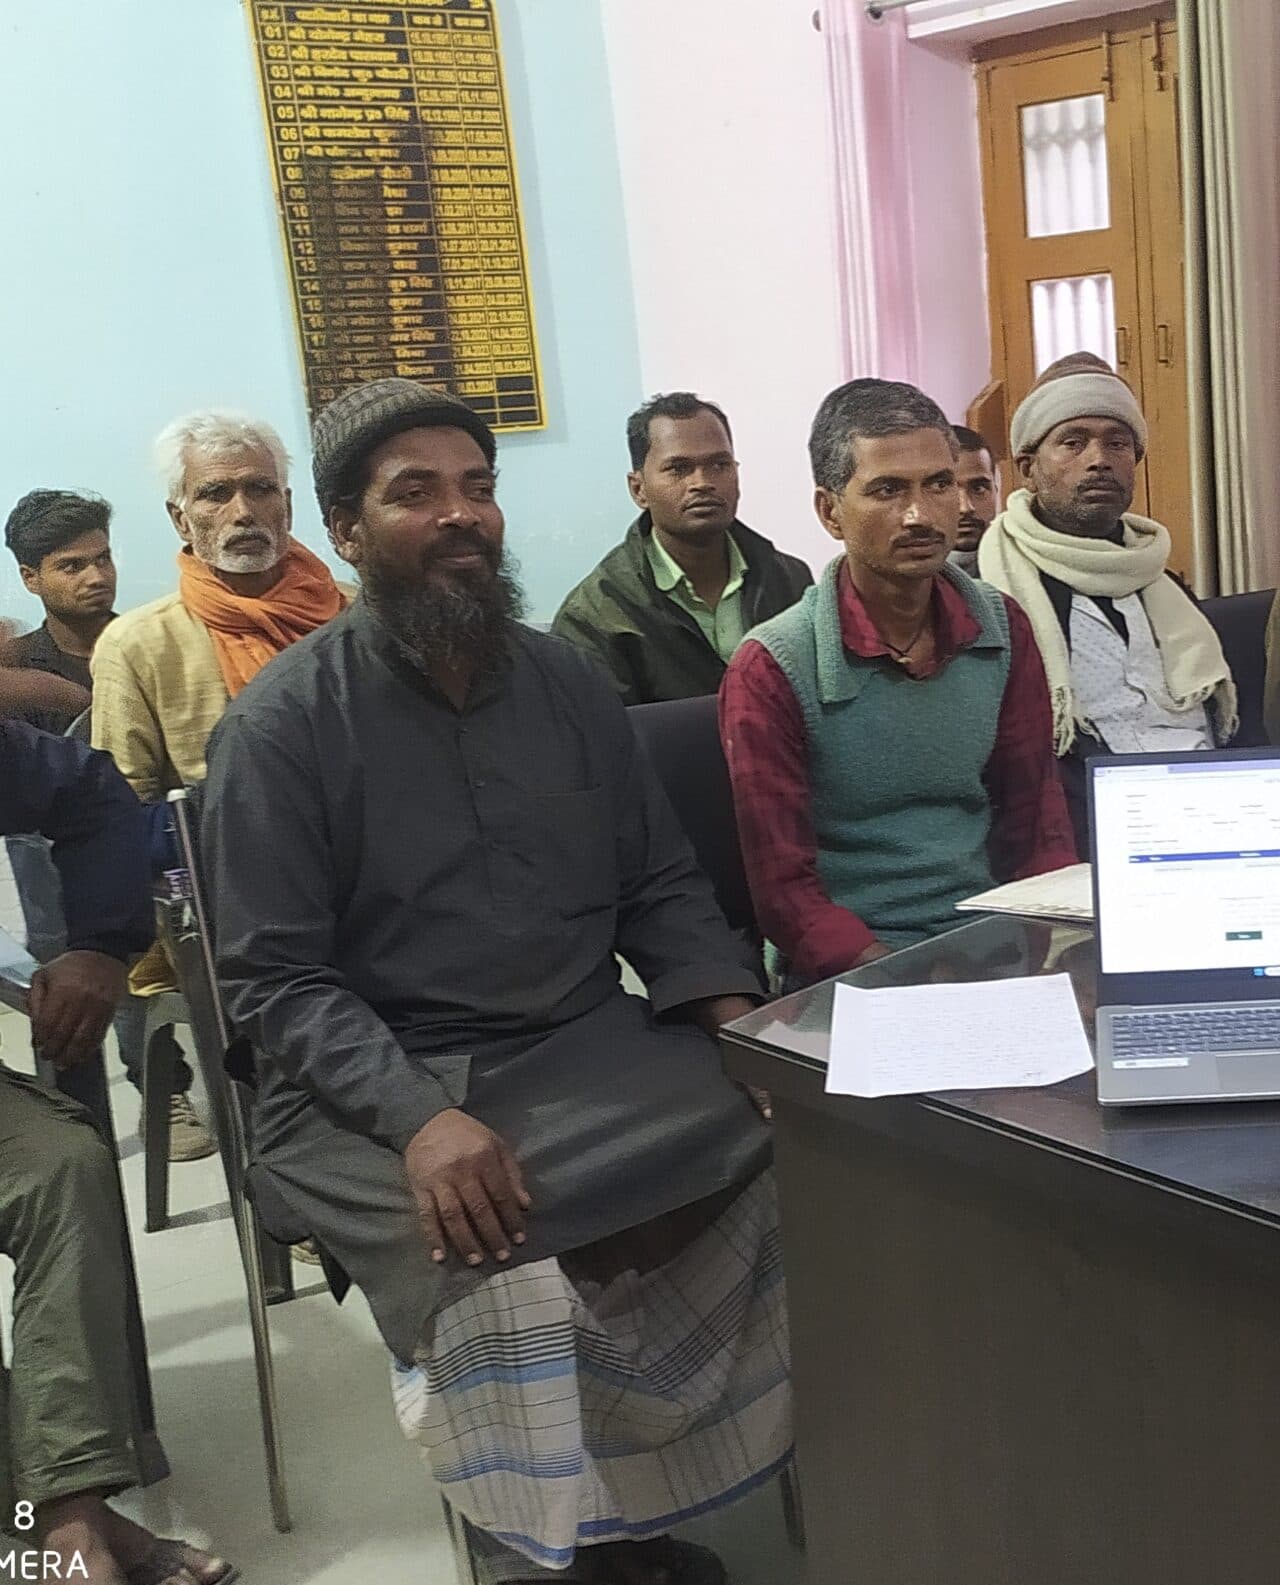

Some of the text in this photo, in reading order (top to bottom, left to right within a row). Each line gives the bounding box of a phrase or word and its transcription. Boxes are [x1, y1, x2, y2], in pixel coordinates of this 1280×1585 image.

[264, 27, 282, 38] 01
[267, 45, 285, 57] 02
[270, 66, 288, 78] 03
[274, 86, 292, 98] 04
[277, 106, 294, 119] 05
[281, 127, 298, 140] 06
[283, 147, 300, 160] 07
[293, 205, 309, 218] 10
[295, 223, 311, 236] 11
[298, 241, 314, 254] 12
[300, 260, 317, 272] 13
[303, 280, 320, 292] 14
[306, 299, 322, 311] 15
[311, 334, 327, 346] 17
